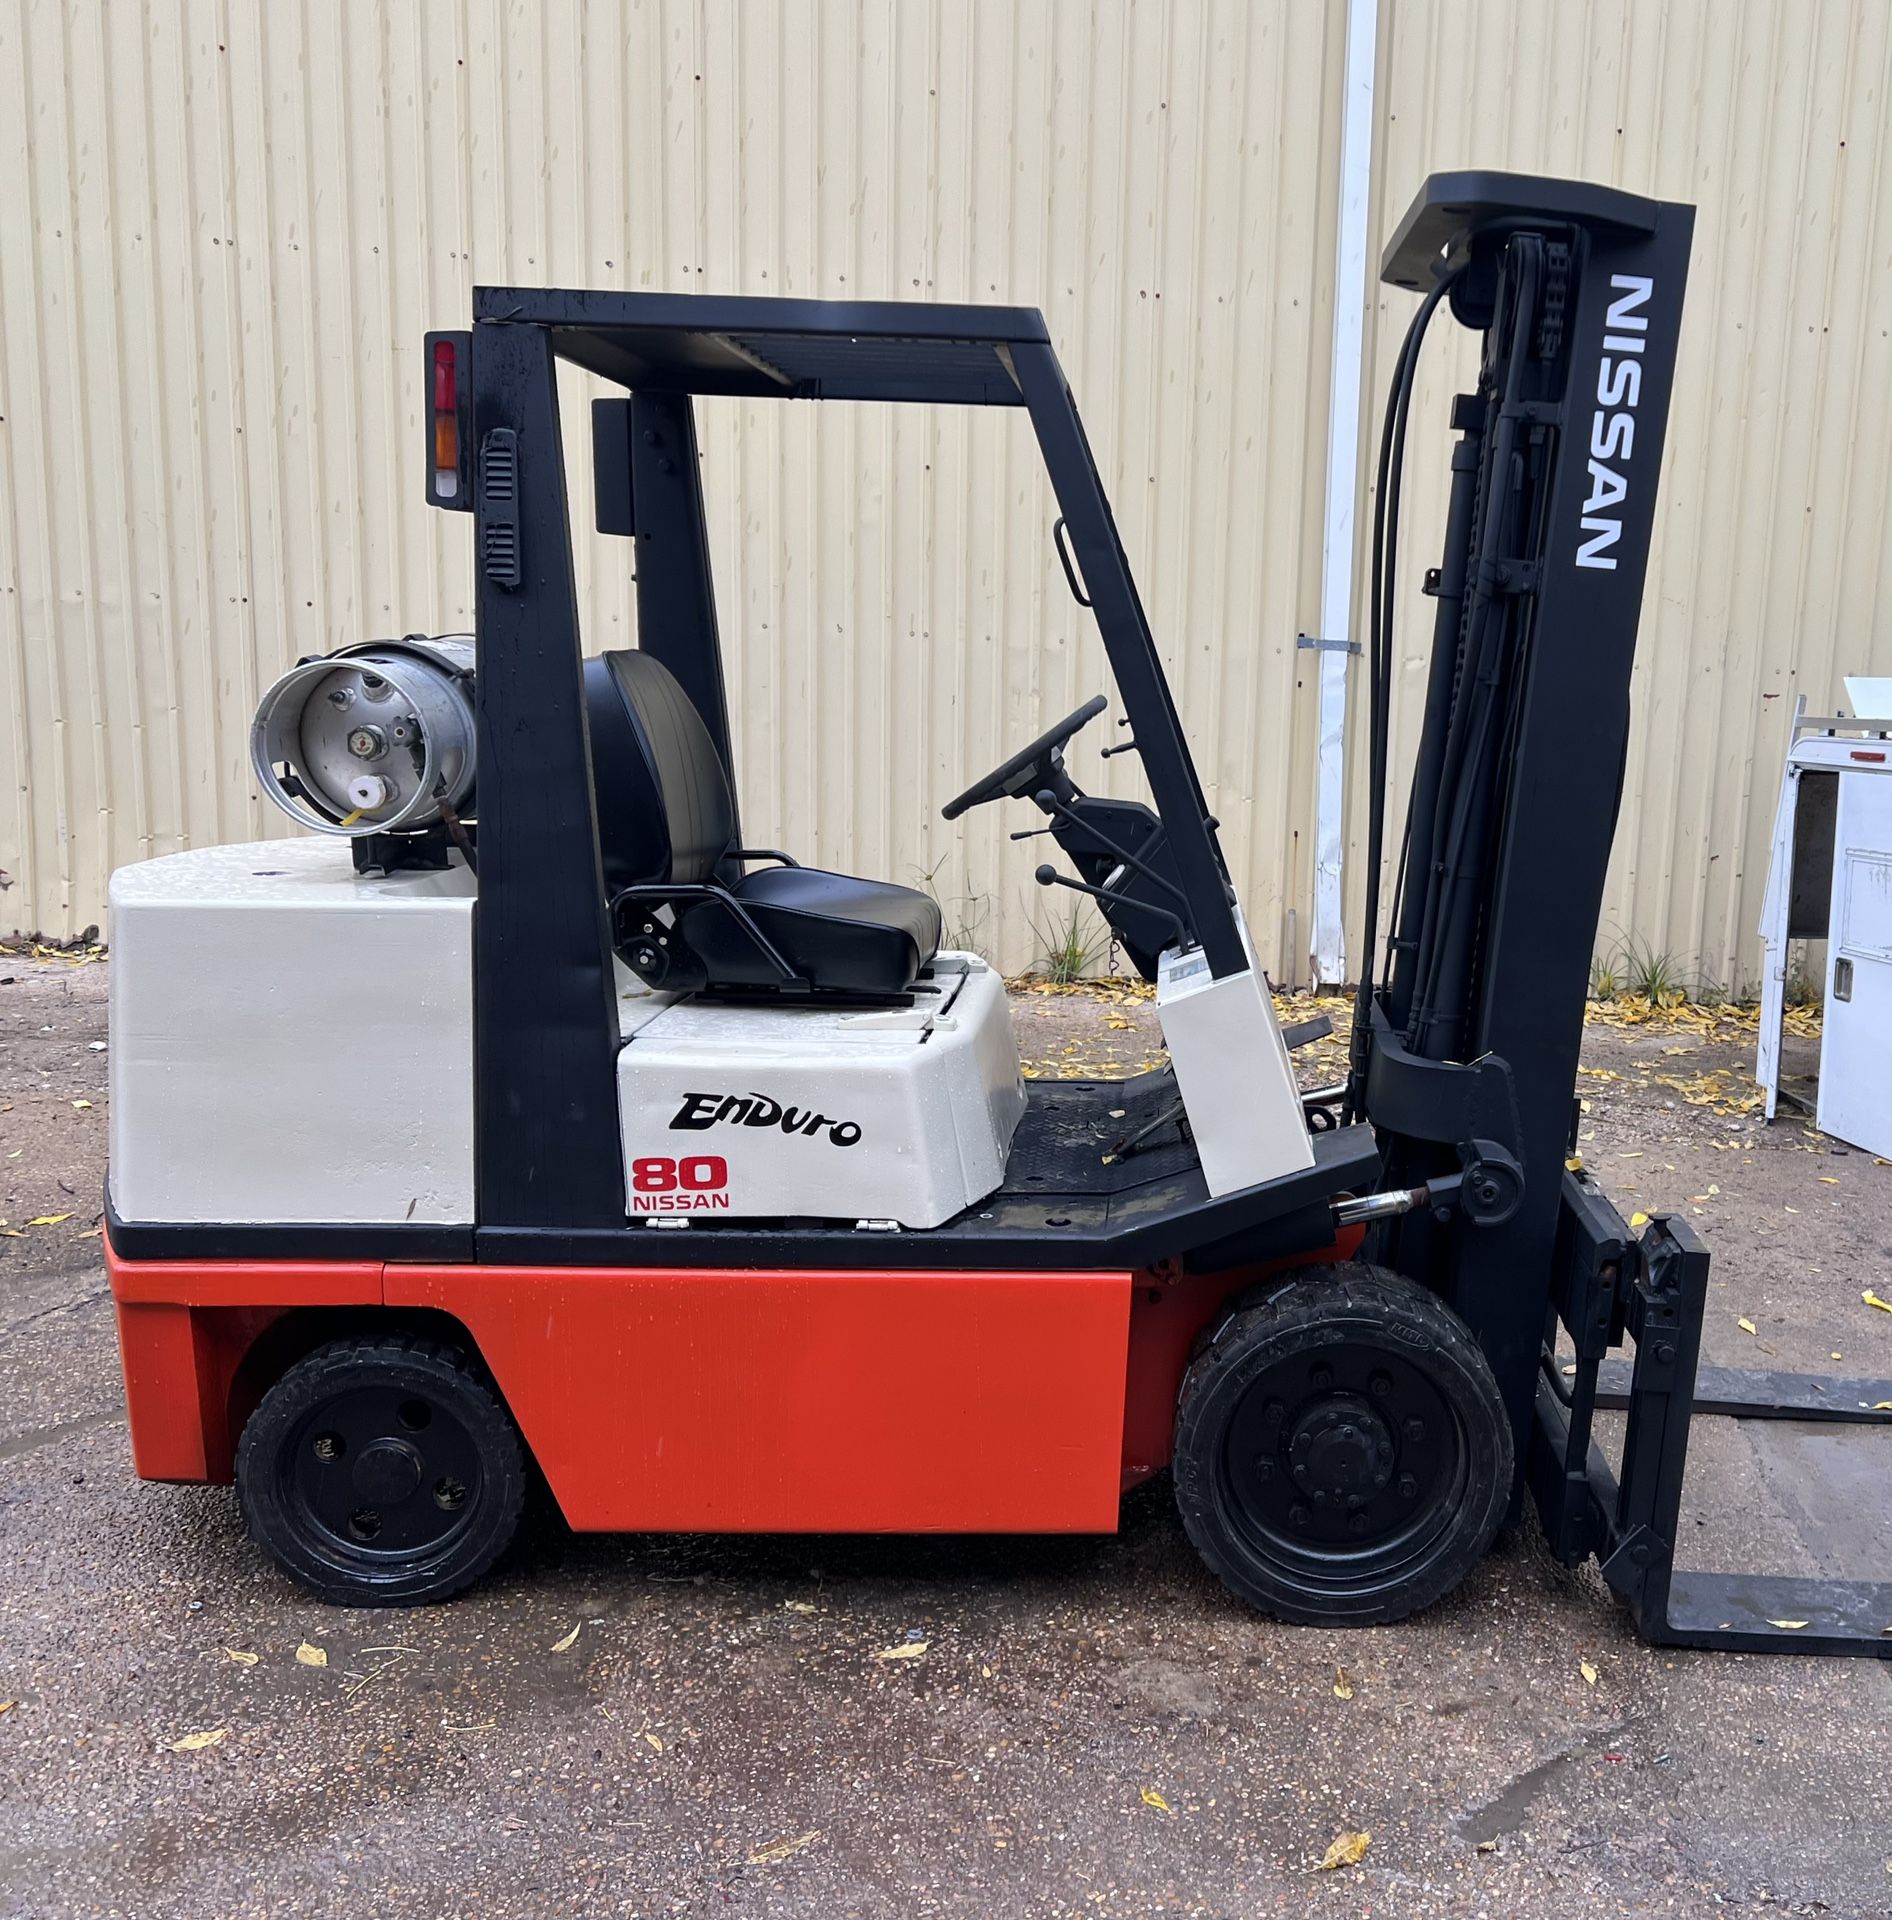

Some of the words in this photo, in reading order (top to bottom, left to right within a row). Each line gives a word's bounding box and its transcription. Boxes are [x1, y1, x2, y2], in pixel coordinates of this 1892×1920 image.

[1575, 274, 1654, 570] NISSAN
[632, 1156, 728, 1191] 80
[633, 1193, 729, 1211] NISSAN
